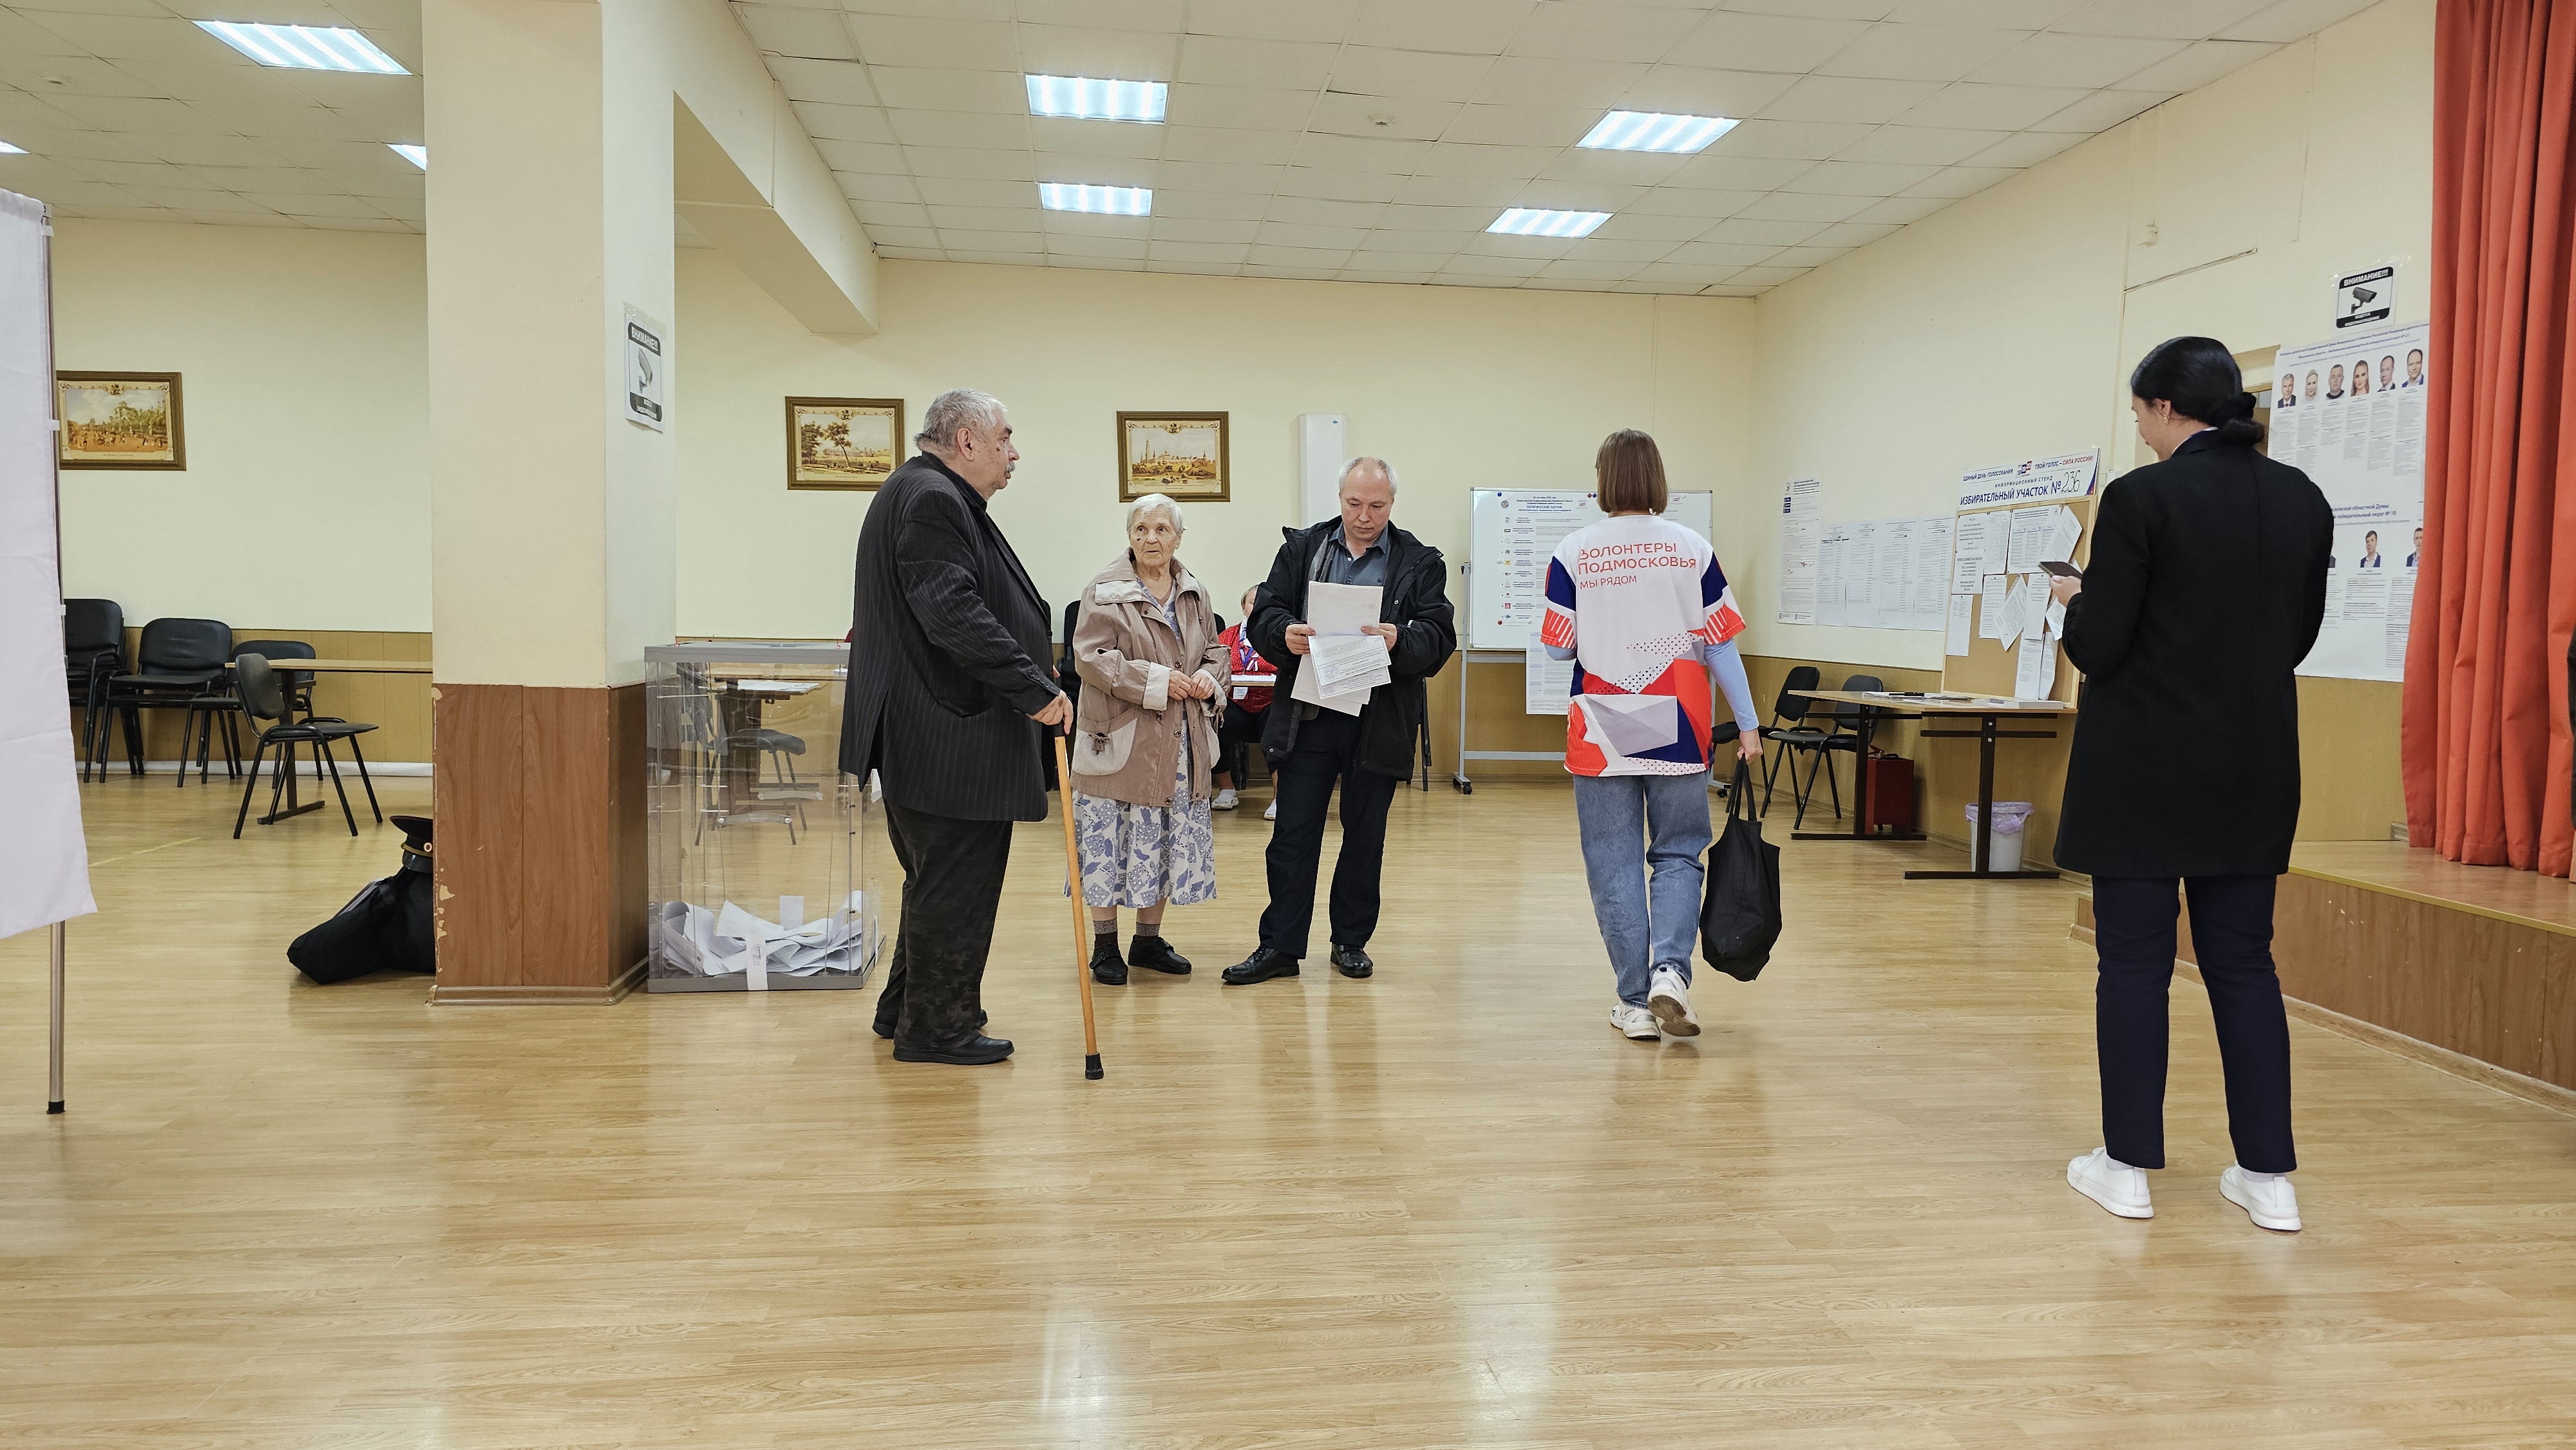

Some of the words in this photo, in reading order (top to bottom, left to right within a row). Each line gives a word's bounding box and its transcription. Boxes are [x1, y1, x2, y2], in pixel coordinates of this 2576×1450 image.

[2344, 268, 2389, 286] ВНИМАНИЕ!!!
[2045, 460, 2059, 468] ГОЛОС
[2074, 455, 2094, 464] РОССИИ!
[1987, 468, 2014, 478] ГОЛОСОВАНИЯ
[1960, 487, 2015, 506] ИЗБИРАТЕЛЬНЫЙ
[2016, 485, 2049, 499] УЧАСТОК
[2050, 480, 2061, 494] №
[2061, 469, 2081, 493] 236
[1994, 477, 2038, 488] ИНФОРМАЦИОННЫЙ
[1578, 556, 1696, 575] ПОДМОСКОВЬЯ
[1580, 580, 1598, 589] МЫ
[1600, 575, 1637, 587] РЯДОМ
